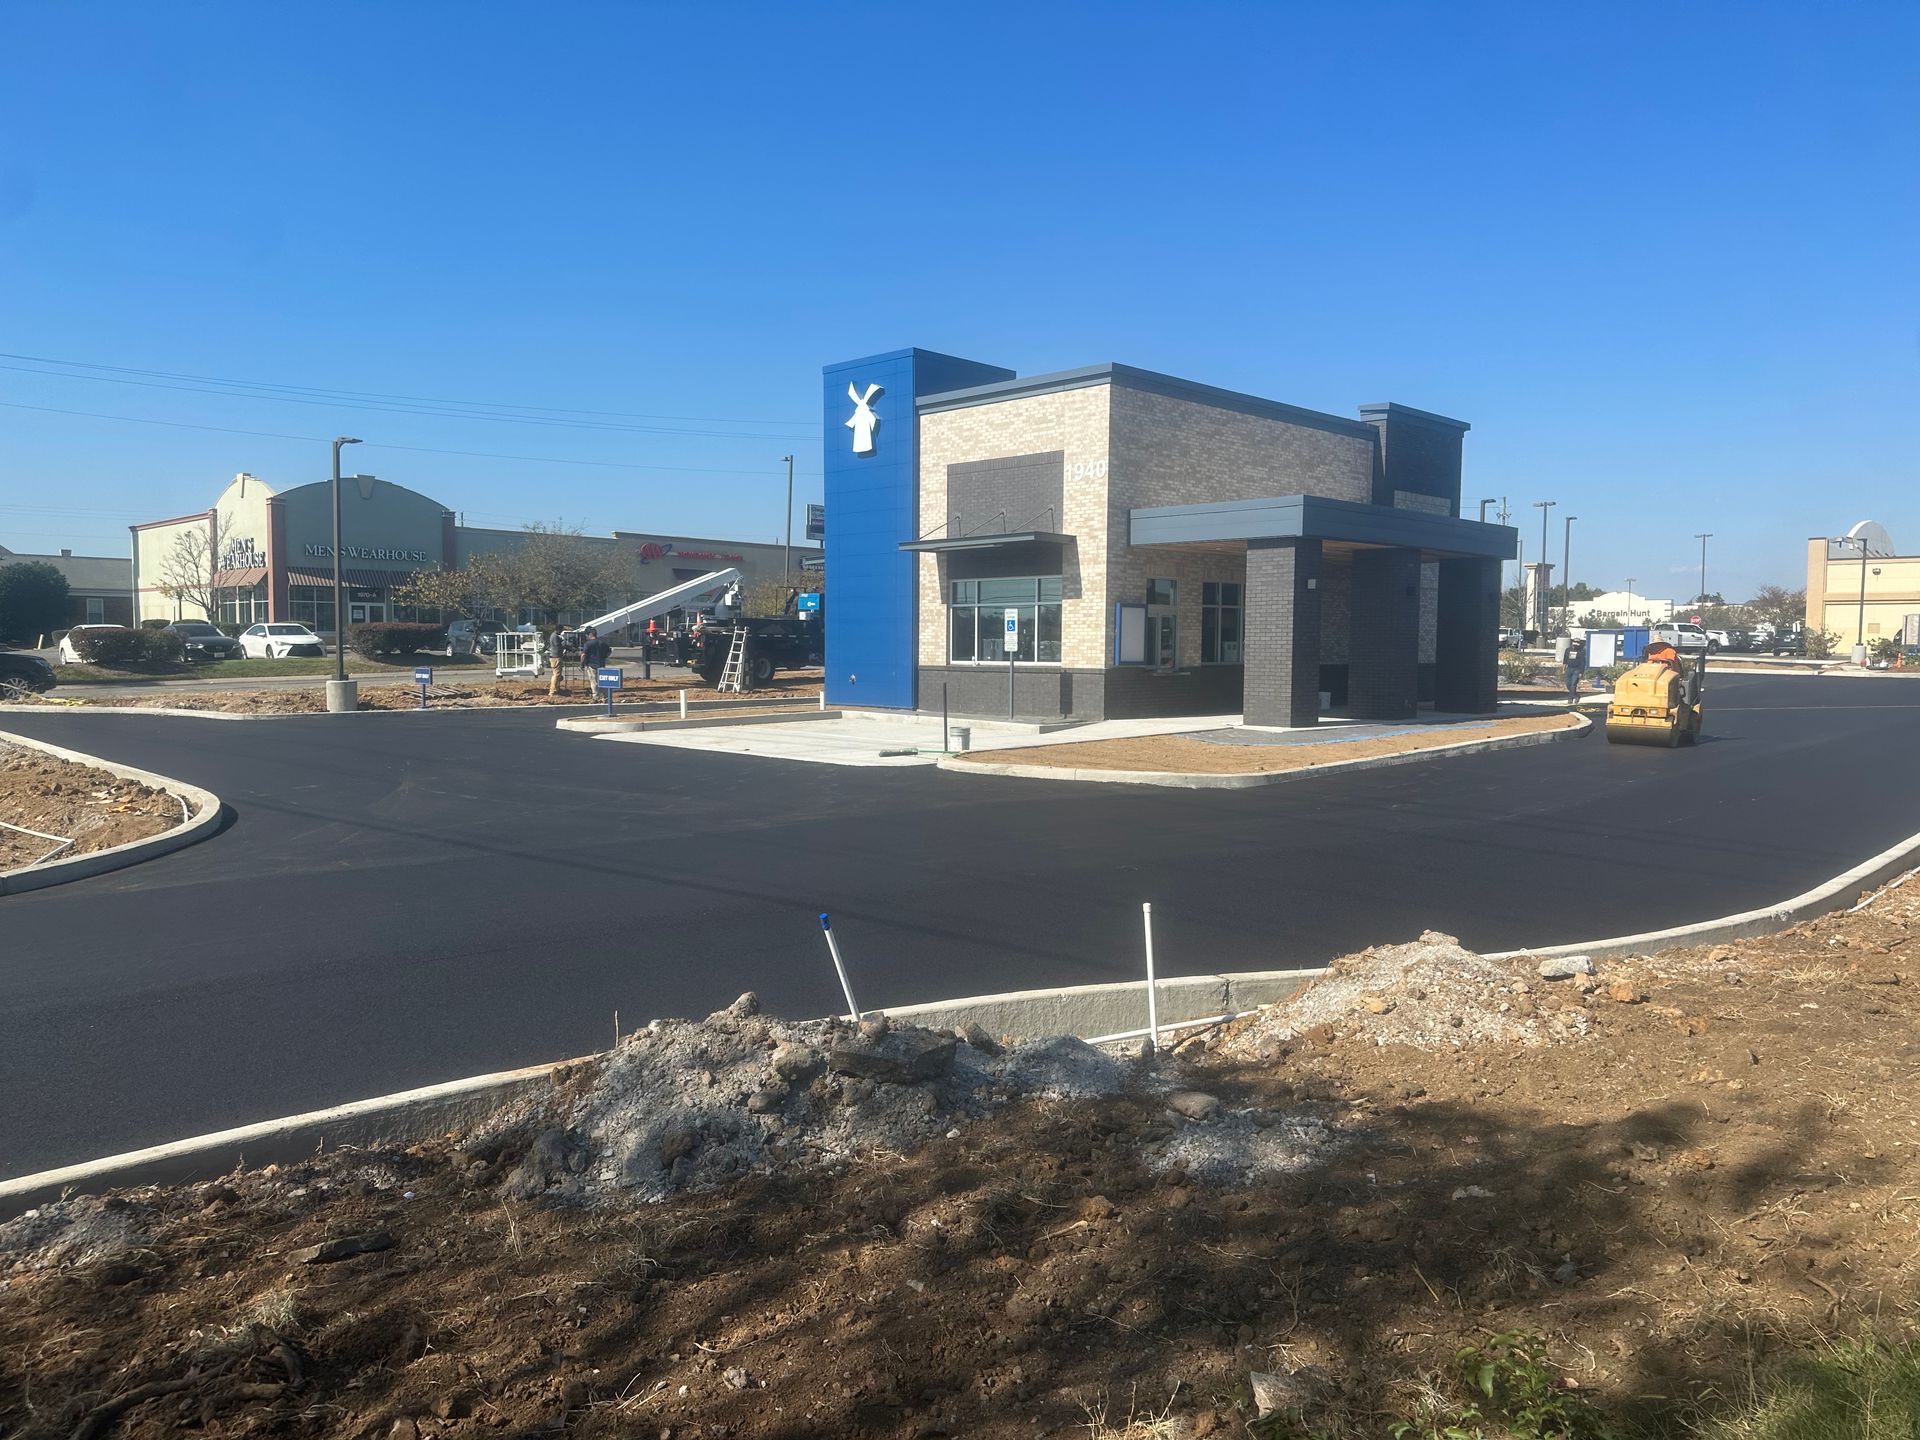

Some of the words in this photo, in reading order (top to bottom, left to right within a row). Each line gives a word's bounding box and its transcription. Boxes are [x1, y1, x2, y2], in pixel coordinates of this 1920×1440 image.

[1064, 460, 1106, 481] 1940
[305, 544, 346, 557] MENS
[347, 546, 427, 561] WEARHOUSE
[1596, 609, 1628, 618] Bargain
[1630, 609, 1651, 617] Hunt
